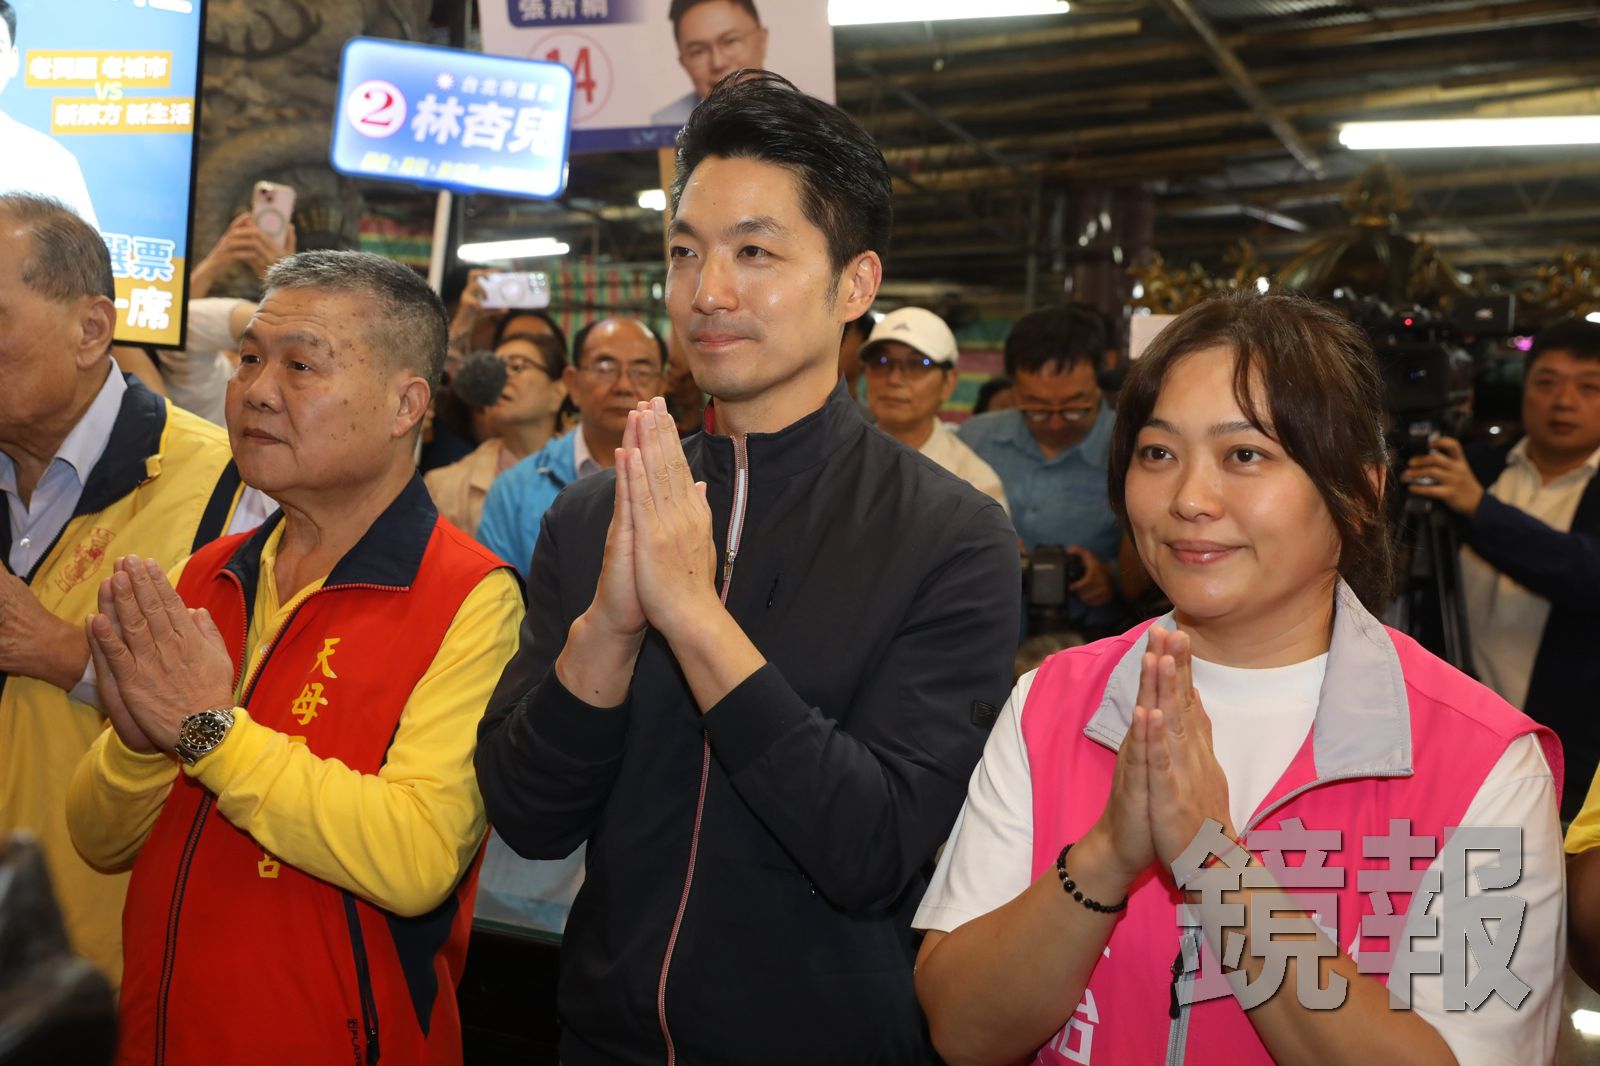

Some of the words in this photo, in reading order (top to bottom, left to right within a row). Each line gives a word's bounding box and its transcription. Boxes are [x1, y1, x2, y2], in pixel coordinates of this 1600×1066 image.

[546, 47, 597, 104] 4
[360, 89, 394, 127] 2
[411, 94, 564, 157] 林杏兒
